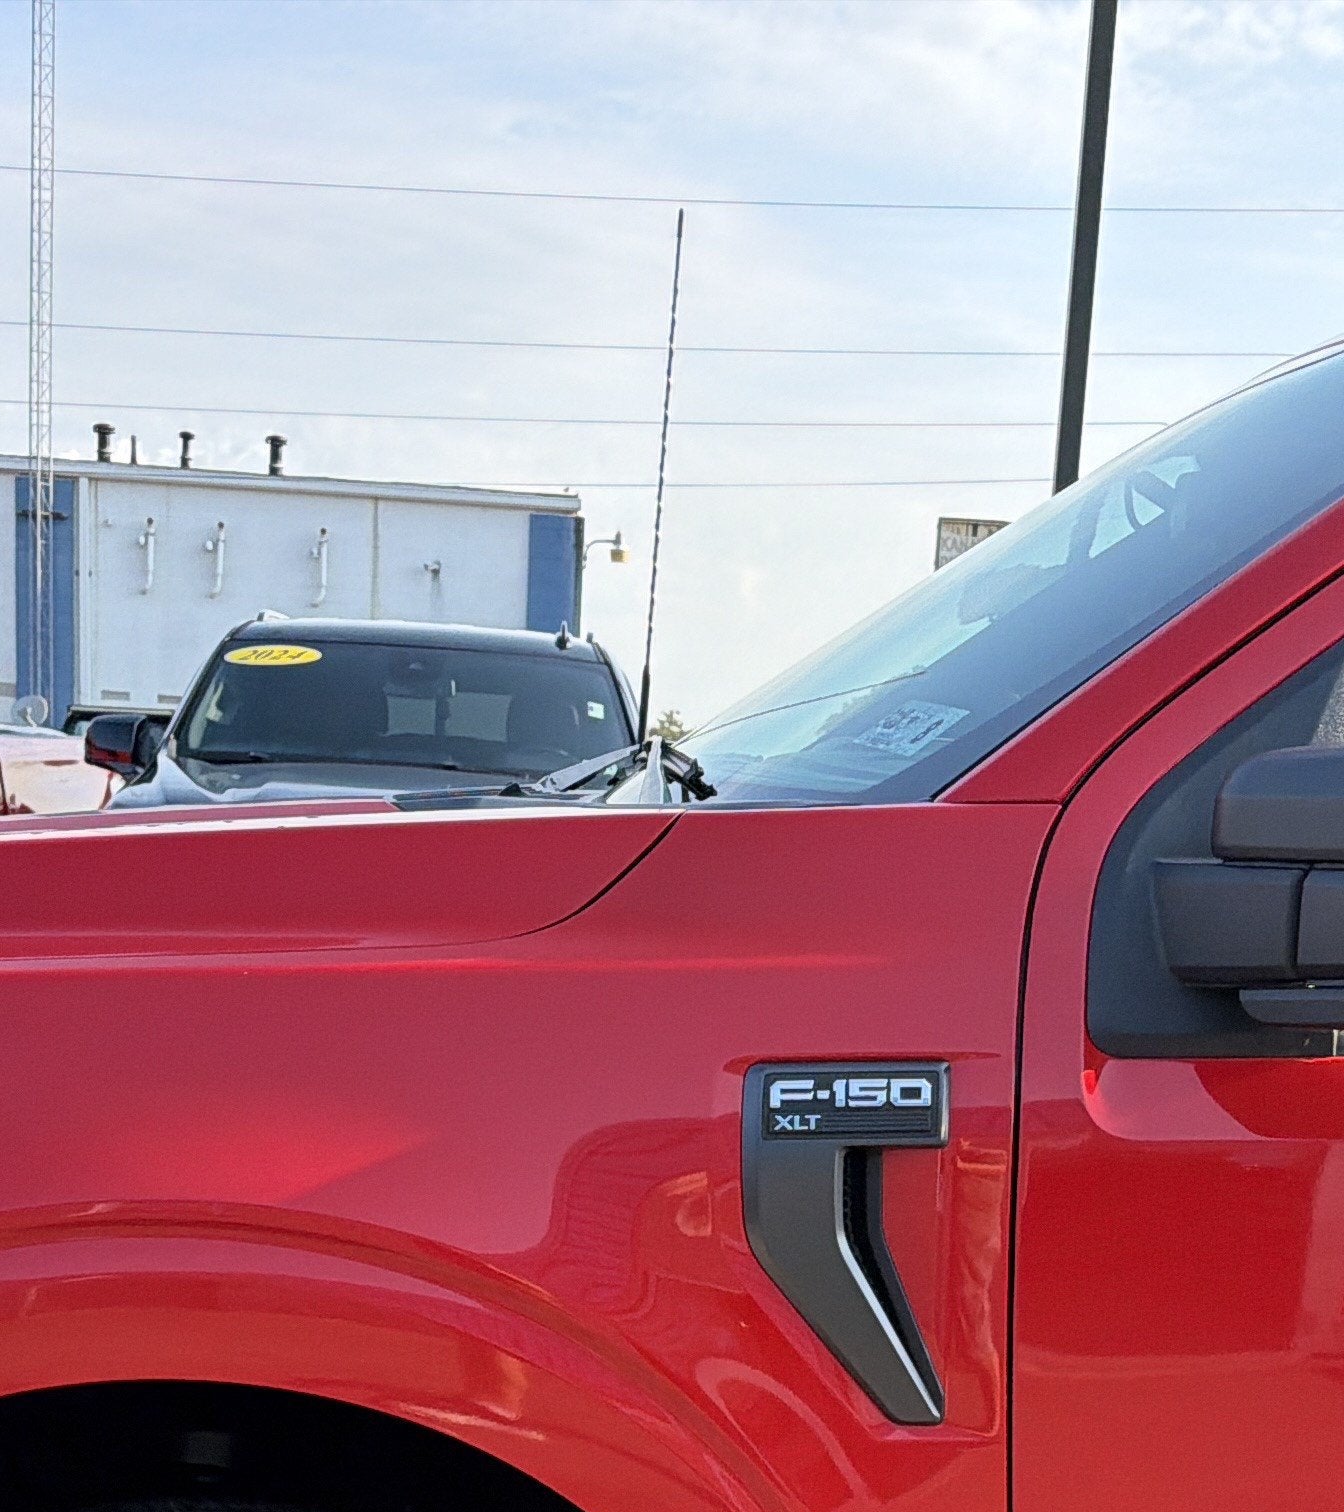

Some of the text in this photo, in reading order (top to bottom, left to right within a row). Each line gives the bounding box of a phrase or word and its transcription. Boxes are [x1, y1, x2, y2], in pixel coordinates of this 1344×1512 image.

[237, 649, 309, 662] 2024
[768, 1077, 933, 1109] F-150
[773, 1114, 822, 1131] XLT
